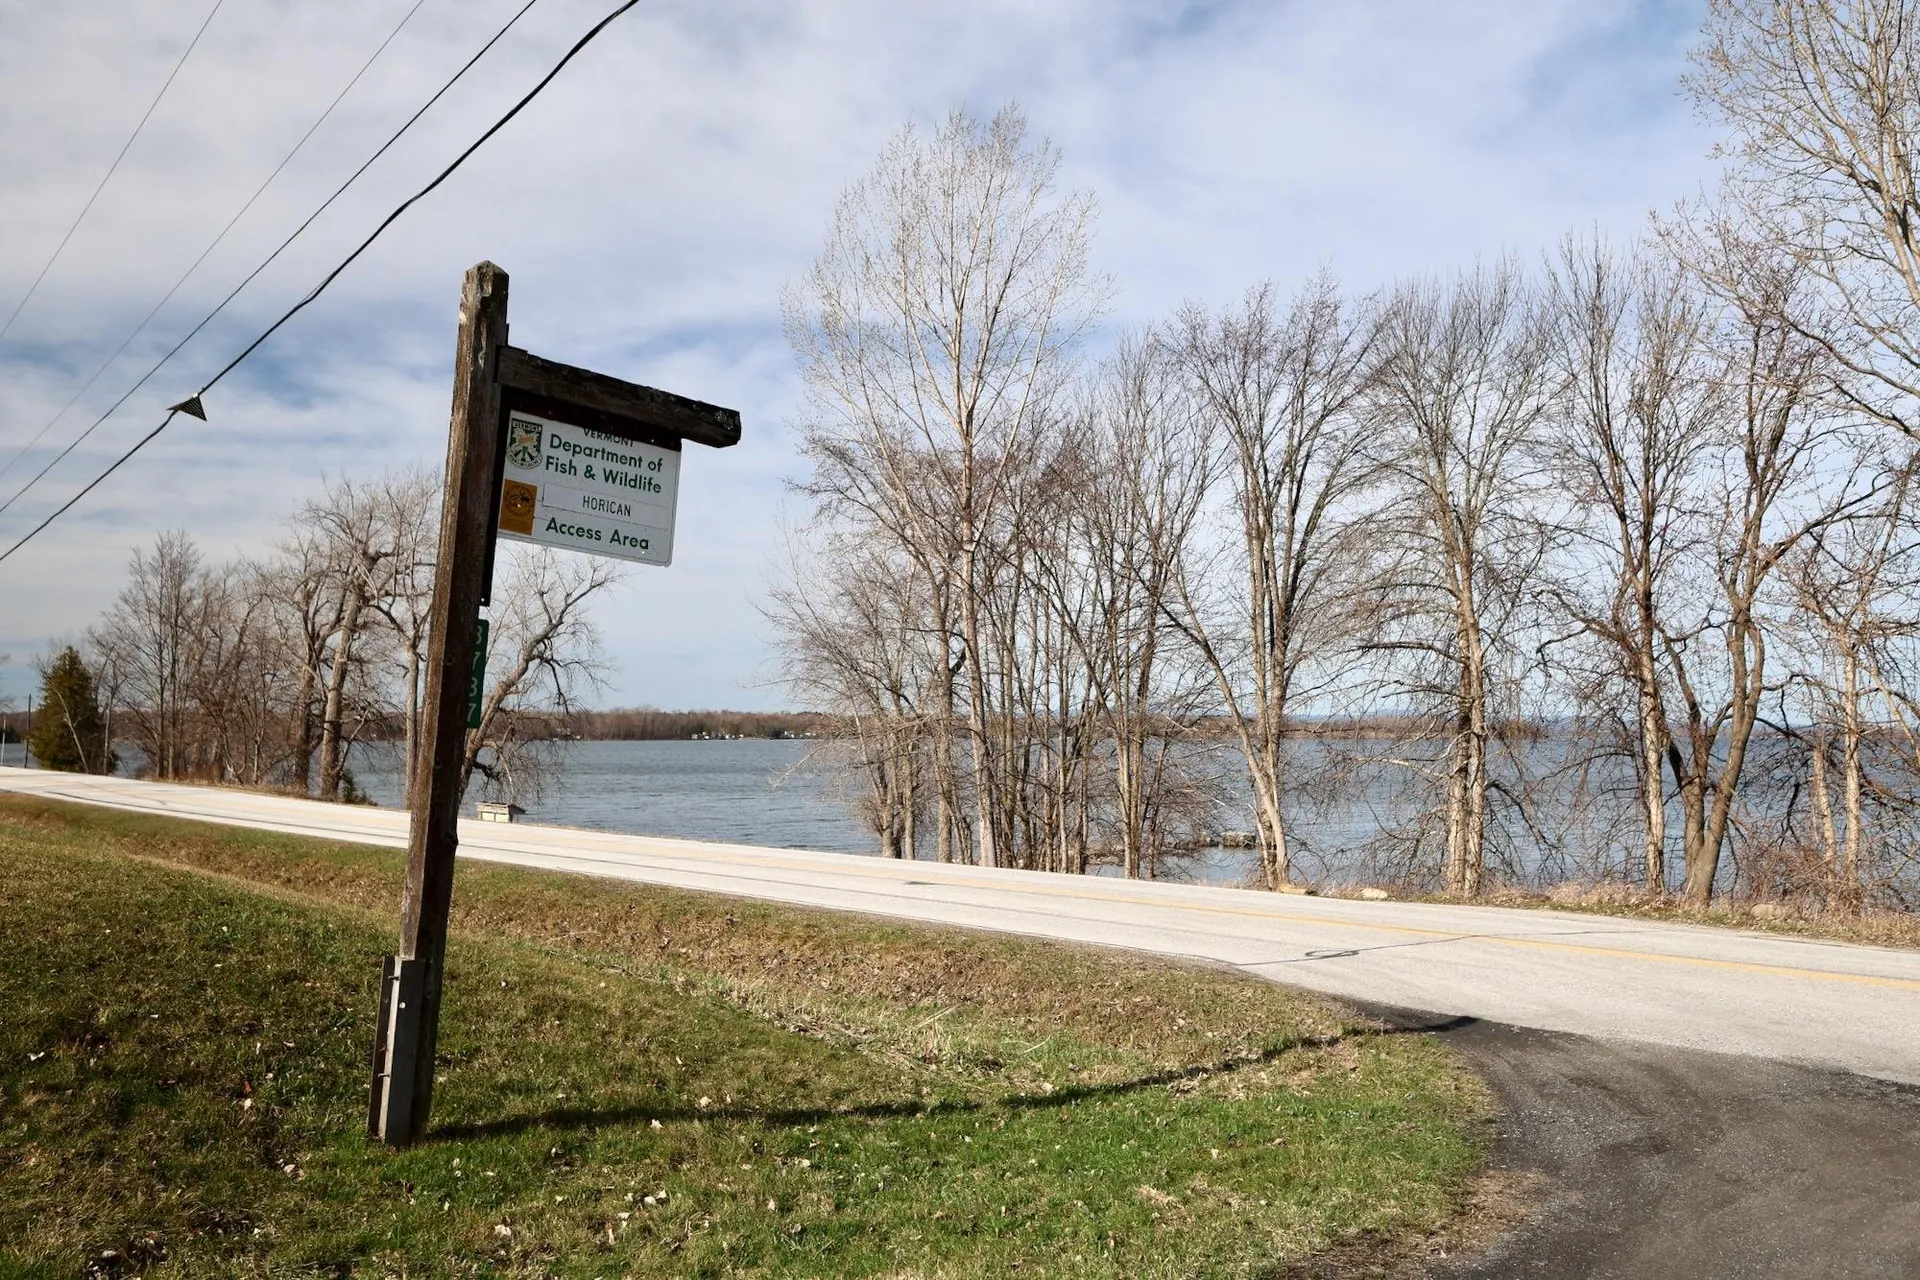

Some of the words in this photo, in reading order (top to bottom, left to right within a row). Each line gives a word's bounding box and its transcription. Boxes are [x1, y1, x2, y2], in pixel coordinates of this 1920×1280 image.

[549, 433, 643, 469] Department
[647, 457, 664, 473] of
[583, 427, 635, 448] VERMONT
[545, 455, 577, 476] Fish
[584, 464, 596, 481] &
[603, 467, 662, 494] Wildlife
[582, 495, 632, 517] HORICAN
[545, 516, 602, 541] Access
[609, 529, 650, 550] Area
